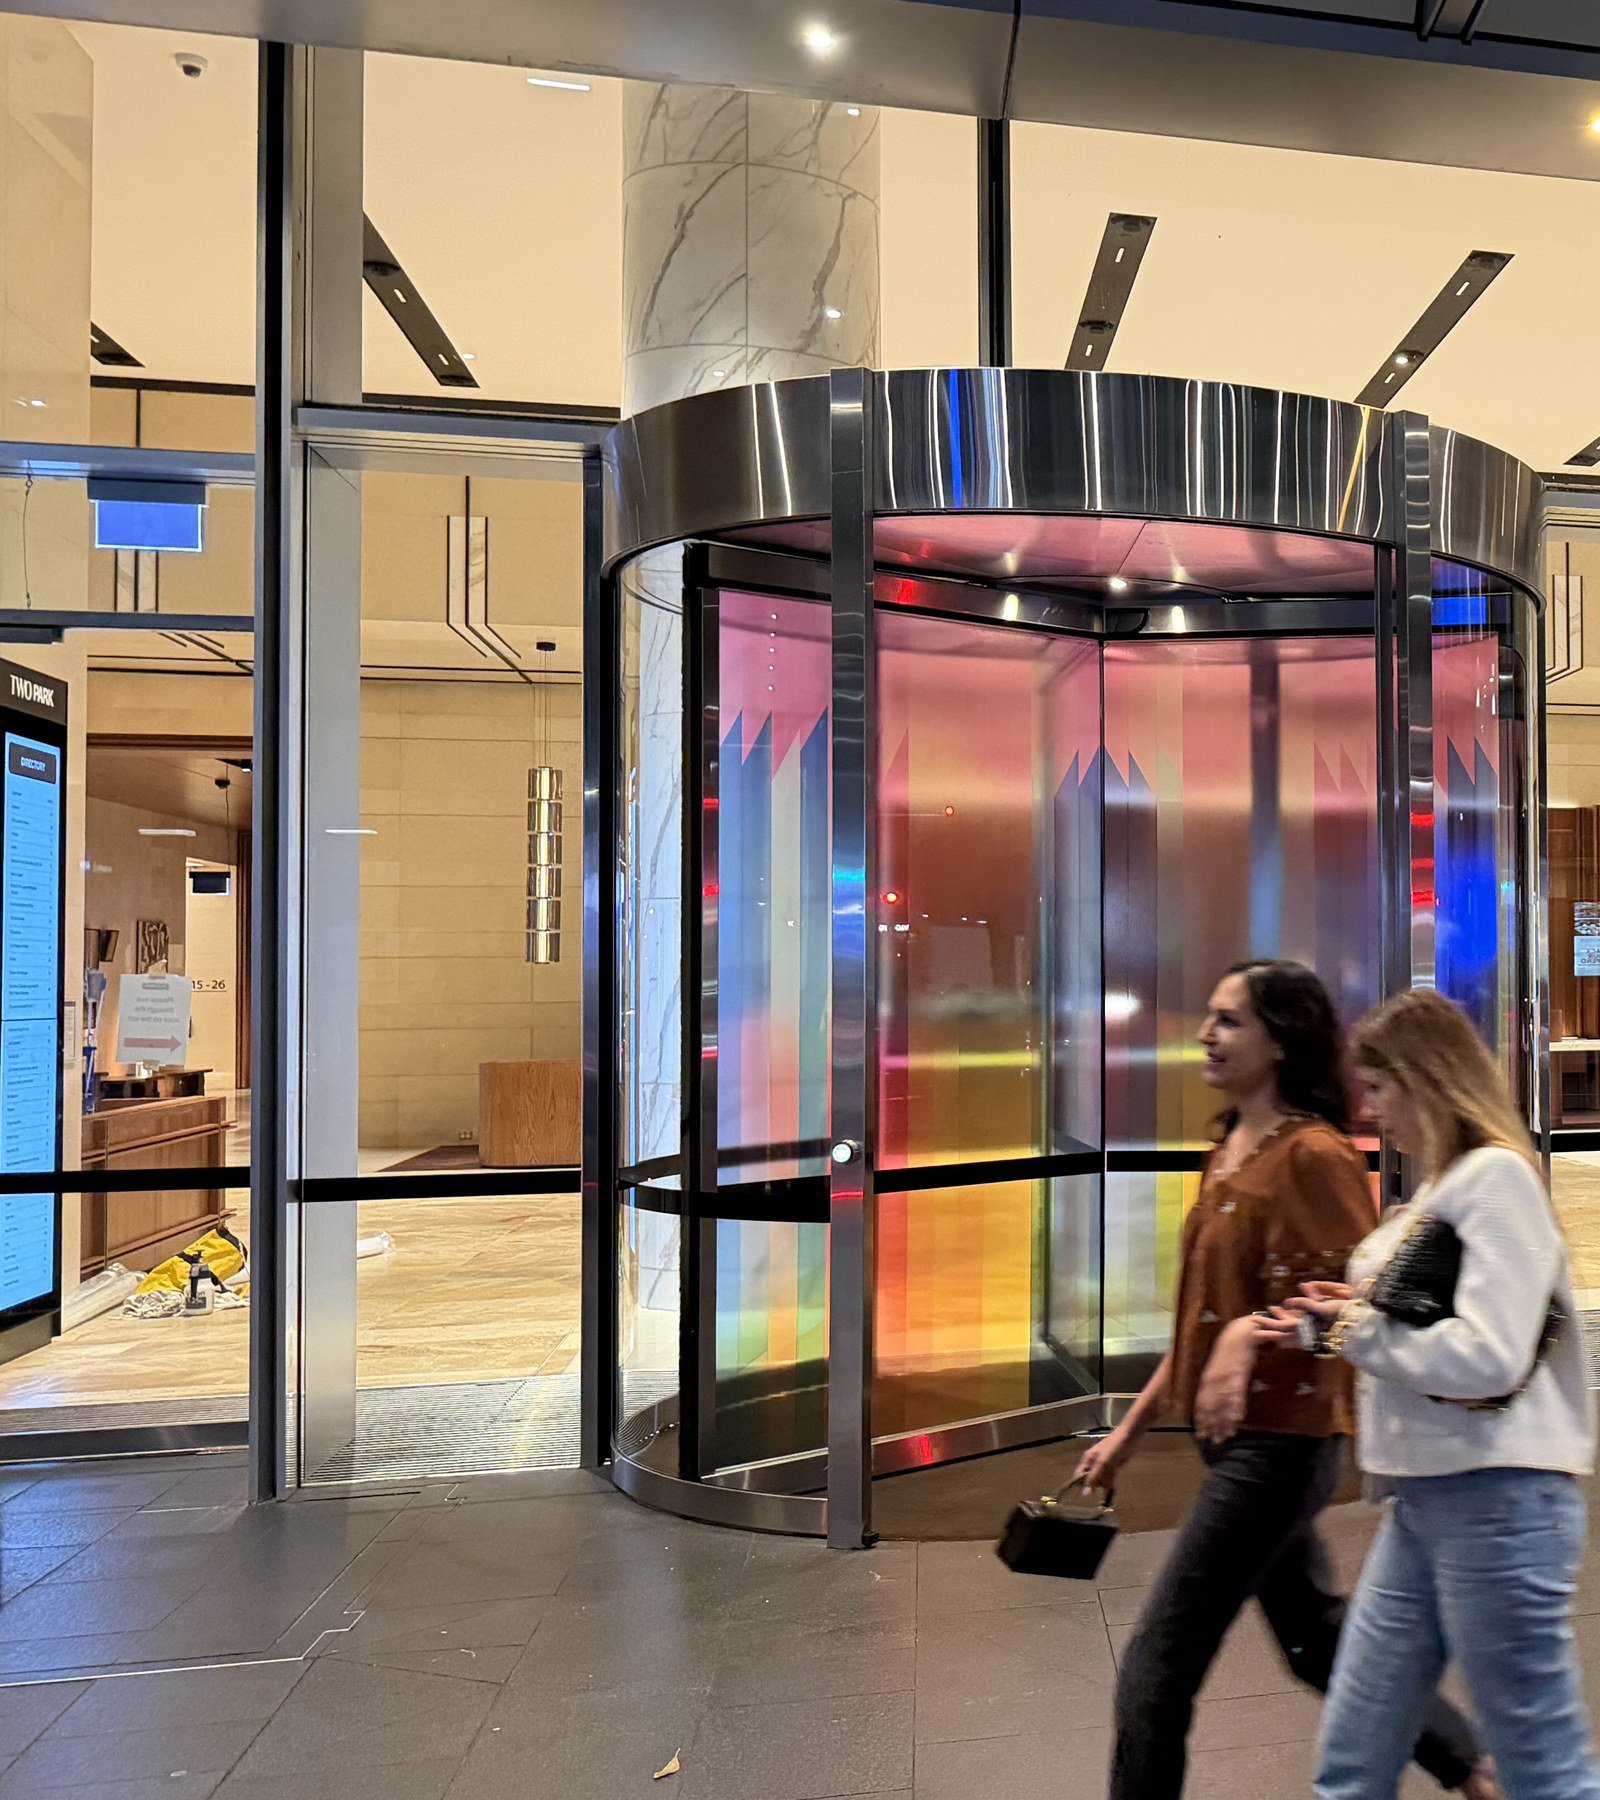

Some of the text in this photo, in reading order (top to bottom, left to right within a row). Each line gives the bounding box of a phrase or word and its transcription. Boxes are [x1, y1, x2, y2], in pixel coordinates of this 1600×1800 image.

[10, 674, 55, 708] TWO PARK
[21, 756, 46, 772] DIRECTORY
[192, 980, 203, 990] 15
[211, 980, 226, 990] 26
